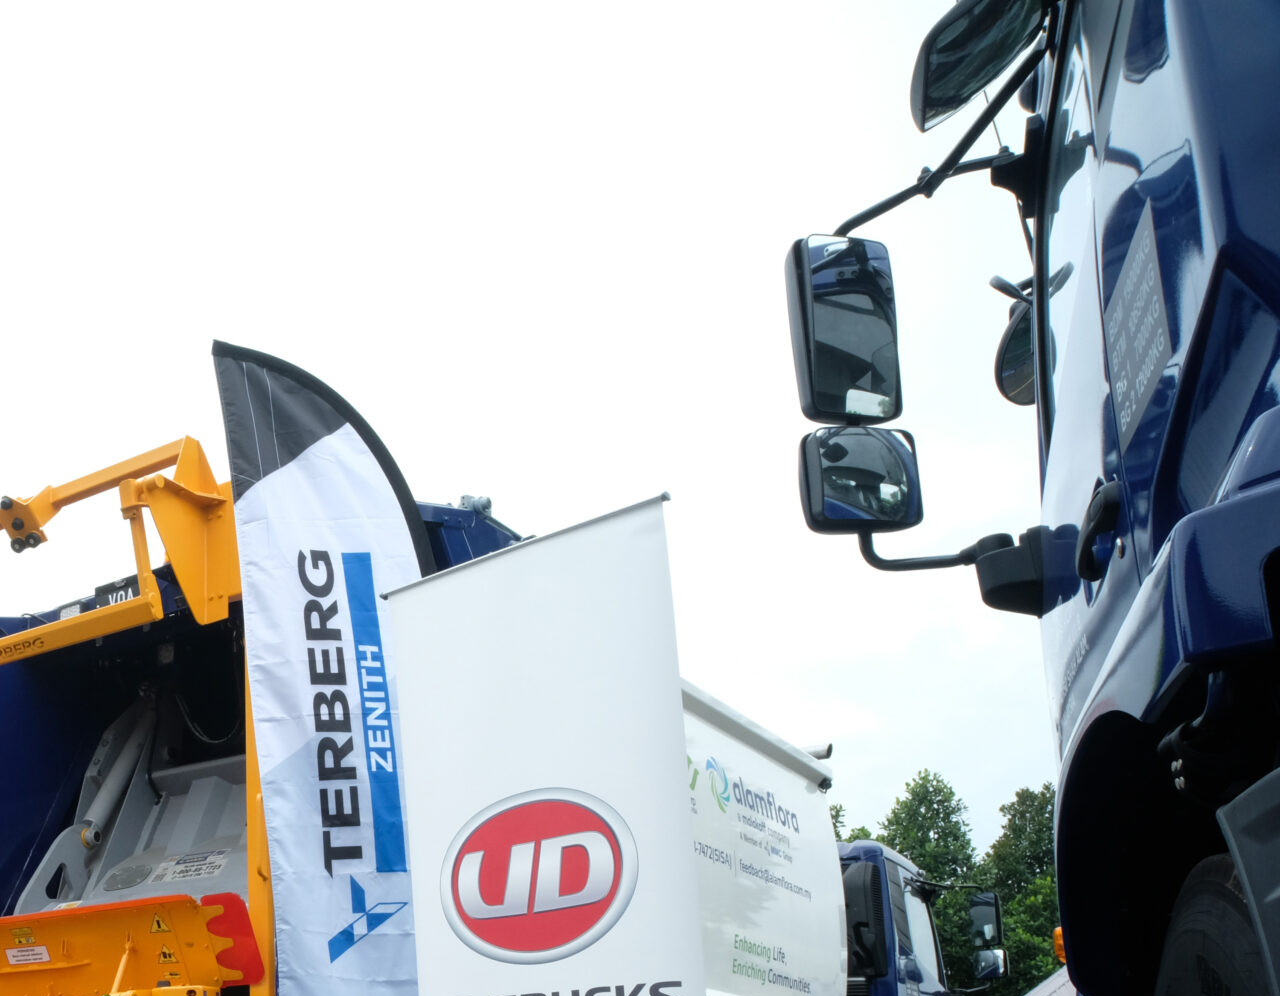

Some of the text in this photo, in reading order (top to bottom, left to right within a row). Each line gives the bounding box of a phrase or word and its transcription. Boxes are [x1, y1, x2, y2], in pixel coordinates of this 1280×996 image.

[1112, 330, 1127, 373] BTM
[1120, 402, 1131, 433] BG
[1135, 327, 1165, 398] 12000KG
[1116, 370, 1128, 402] BG
[298, 549, 363, 878] TERBERG
[359, 643, 393, 774] ZENITH
[732, 776, 800, 834] alamflora
[457, 830, 615, 920] UD
[732, 958, 767, 986] Enriching
[733, 934, 772, 964] Enhancing
